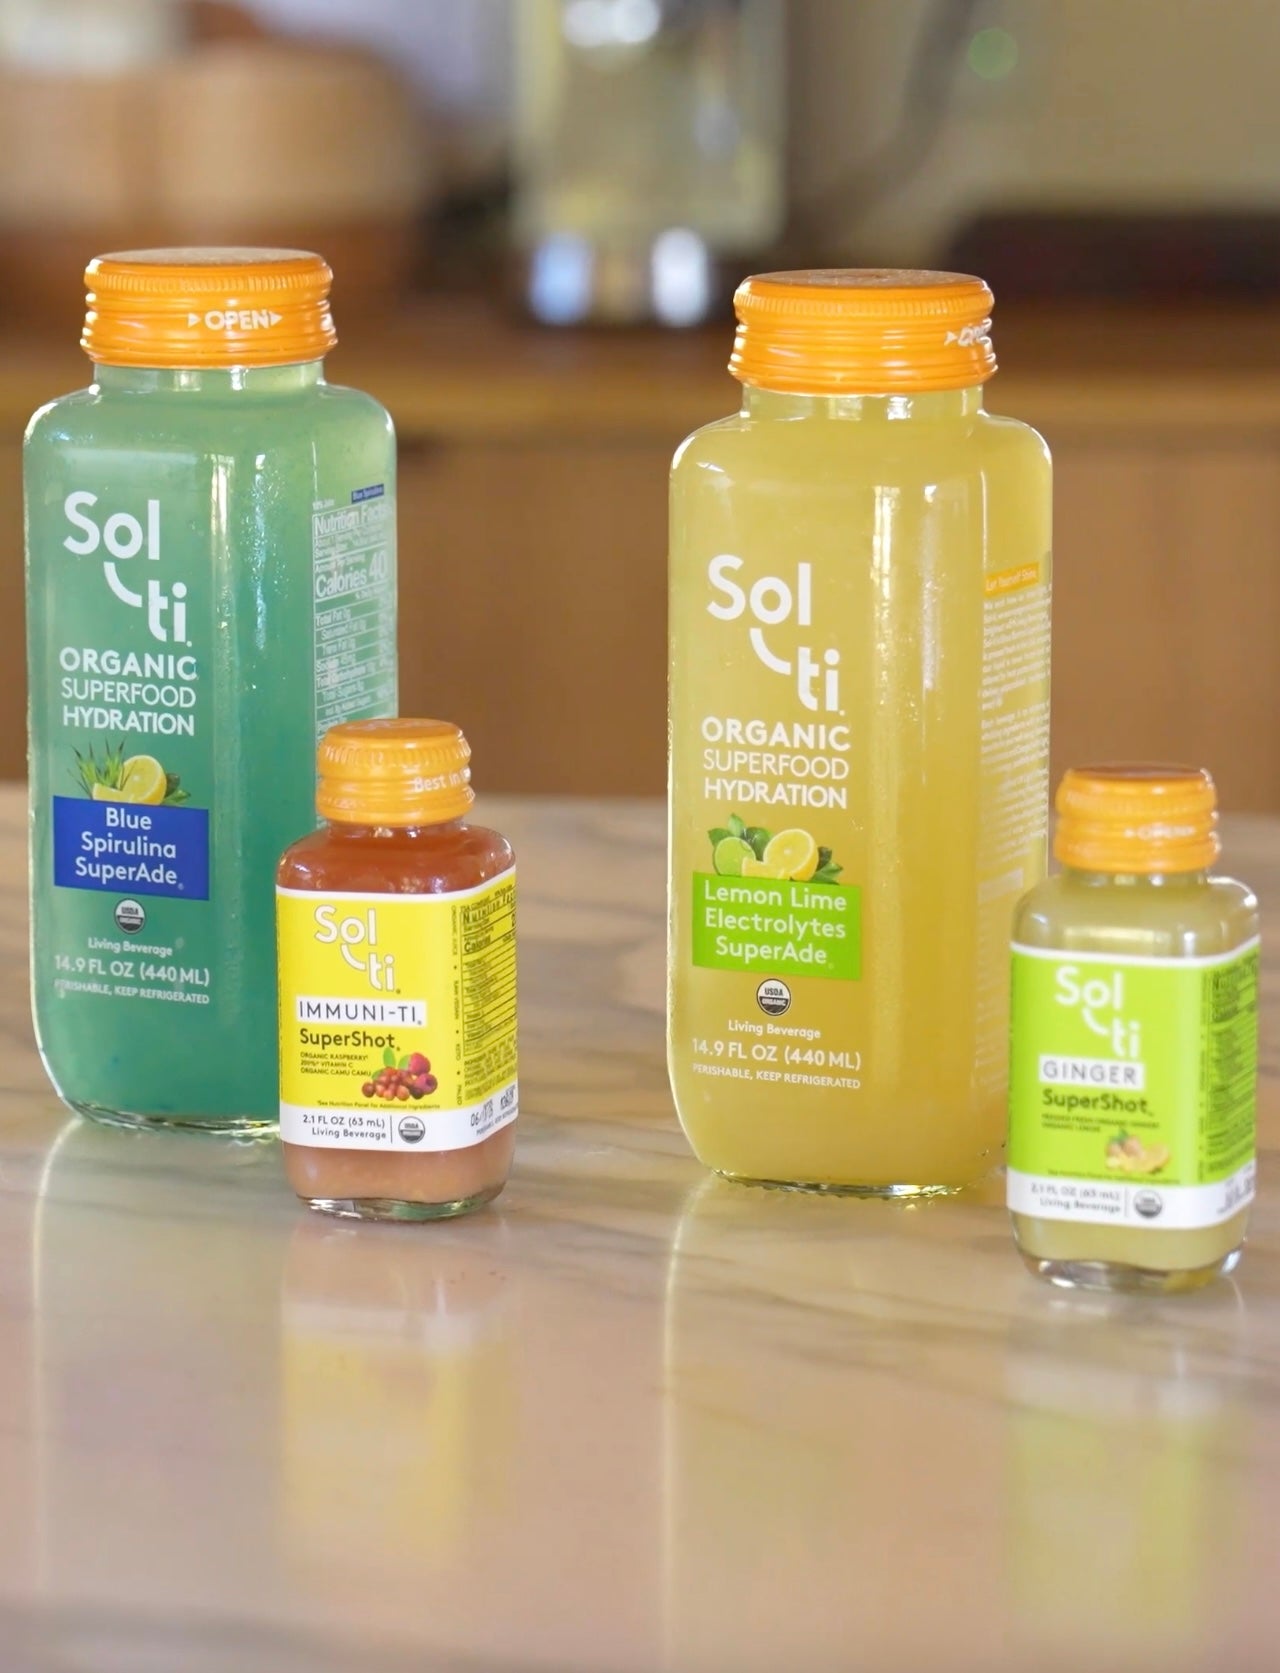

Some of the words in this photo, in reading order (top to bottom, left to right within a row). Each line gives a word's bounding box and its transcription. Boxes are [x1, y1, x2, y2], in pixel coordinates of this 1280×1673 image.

[205, 309, 269, 331] OPEN
[63, 491, 160, 560] Sol
[315, 510, 359, 535] Nutrition
[316, 567, 367, 598] Calories
[369, 550, 388, 580] 40
[706, 554, 811, 626] Sol
[148, 579, 187, 643] ti
[59, 646, 198, 681] ORGANIC
[61, 677, 196, 708] SUPERFOOD
[797, 646, 840, 712] ti
[63, 705, 195, 736] HYDRATION
[701, 716, 851, 751] ORGANIC
[703, 748, 849, 780] SUPERFOOD
[413, 774, 447, 793] Best
[704, 776, 847, 809] HYDRATION
[105, 806, 152, 830] Blue
[81, 831, 177, 859] Spirulina
[75, 856, 178, 885] SuperAde
[704, 879, 783, 907] Lemon
[790, 887, 847, 912] Lime
[314, 904, 377, 945] Sol
[705, 907, 847, 941] Electrolytes
[88, 937, 121, 953] Living
[122, 940, 173, 958] Beverage
[715, 935, 828, 964] SuperAde
[54, 954, 86, 973] 14.9
[88, 958, 106, 976] FL
[110, 960, 135, 978] OZ
[139, 962, 177, 982] (440
[179, 967, 210, 987] ML)
[369, 952, 395, 991] ti
[114, 985, 138, 997] KEEP
[140, 988, 210, 1004] REFRIGERATED
[764, 988, 783, 996] USDA
[1054, 964, 1123, 1010] Sol
[299, 1001, 416, 1022] IMMUNI-TI
[299, 1028, 396, 1050] SuperShot
[728, 1019, 764, 1037] Living
[766, 1023, 821, 1041] Beverage
[1112, 1016, 1141, 1060] ti
[300, 1051, 329, 1059] ORGANIC
[321, 1060, 347, 1068] VITAMIN
[692, 1038, 724, 1057] 14.9
[728, 1042, 747, 1059] FL
[751, 1044, 778, 1062] OZ
[784, 1045, 825, 1067] (440
[829, 1051, 862, 1071] ML)
[300, 1067, 329, 1075] ORGANIC
[330, 1068, 350, 1076] CAMU
[351, 1069, 372, 1077] CAMU
[692, 1062, 753, 1081] PERISHABLE,
[756, 1070, 782, 1082] KEEP
[784, 1072, 861, 1089] REFRIGERATED
[1042, 1060, 1137, 1085] GINGER
[1042, 1088, 1149, 1114] SuperShot
[303, 1114, 315, 1124] 2.1
[317, 1115, 328, 1125] FL
[330, 1115, 345, 1126] OZ
[348, 1116, 364, 1128] (63
[366, 1118, 386, 1130] mL)
[312, 1127, 340, 1138] Living
[343, 1129, 387, 1141] Beverage
